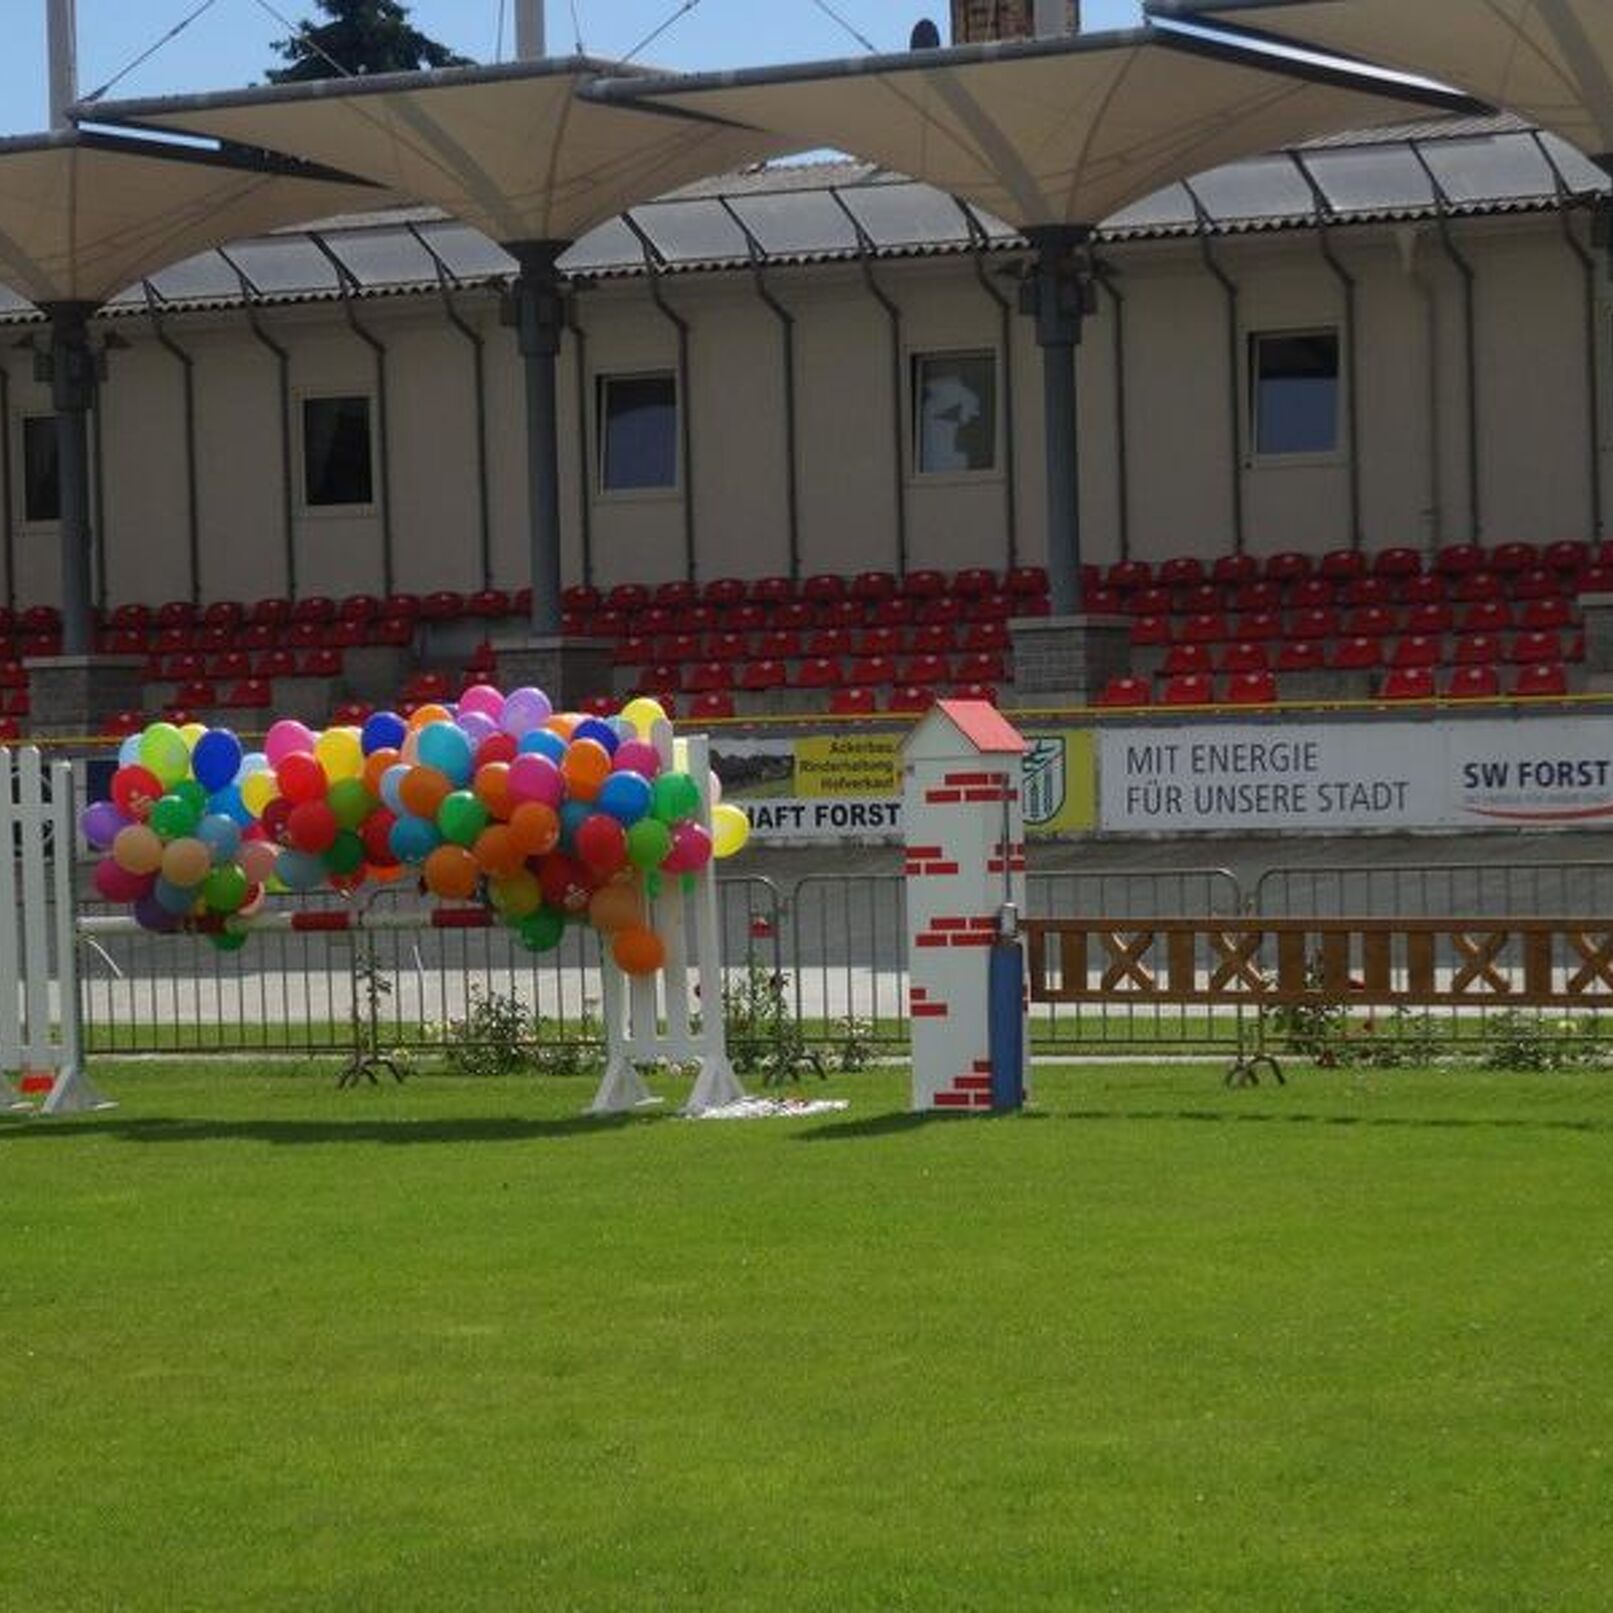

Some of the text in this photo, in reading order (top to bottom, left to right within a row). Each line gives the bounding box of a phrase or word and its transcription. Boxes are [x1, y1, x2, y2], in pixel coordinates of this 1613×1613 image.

[1126, 742, 1319, 774] MIT ENERGIE
[1464, 759, 1610, 788] SW FORST
[1126, 779, 1409, 815] FÜR UNSERE STADT
[815, 802, 902, 827] FORST
